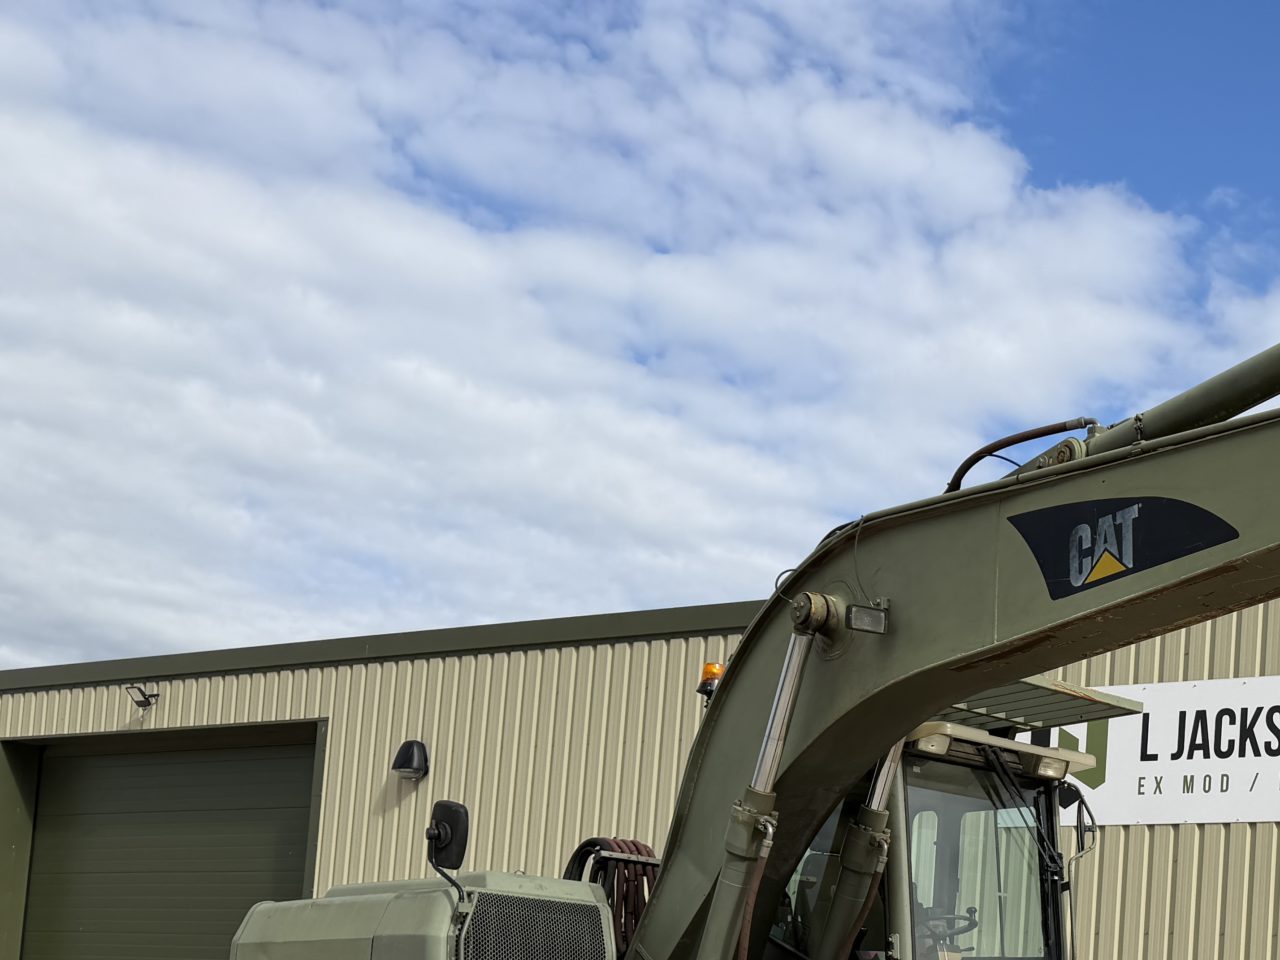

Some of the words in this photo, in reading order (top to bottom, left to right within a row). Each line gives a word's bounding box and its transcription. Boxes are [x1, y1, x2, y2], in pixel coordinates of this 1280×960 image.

[1069, 503, 1139, 587] CAT
[1139, 712, 1159, 762] L
[1137, 775, 1164, 796] EX
[1182, 773, 1230, 794] MOD
[1249, 772, 1260, 792] /
